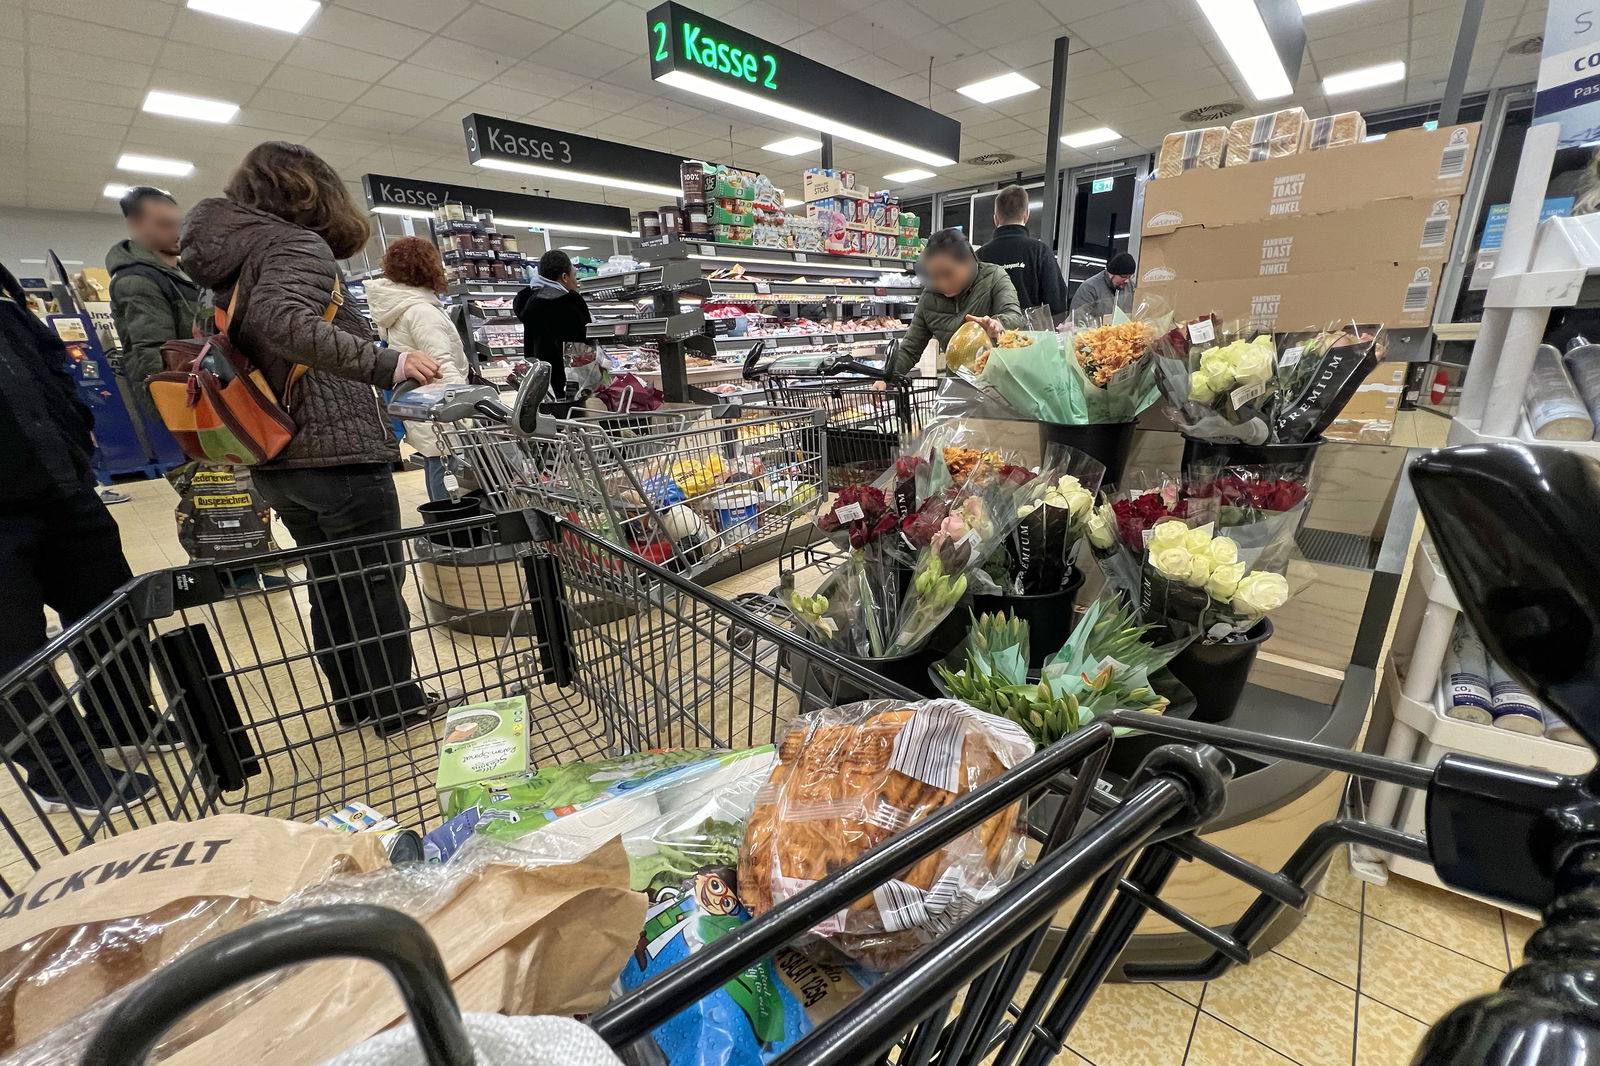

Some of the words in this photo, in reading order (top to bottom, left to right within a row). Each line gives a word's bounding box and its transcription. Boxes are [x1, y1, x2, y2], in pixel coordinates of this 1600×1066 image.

[653, 21, 669, 62] 2
[682, 22, 758, 83] Kasse
[763, 54, 777, 90] 2
[467, 127, 477, 152] 3
[487, 126, 554, 161] Kasse
[559, 140, 572, 164] 3
[1273, 173, 1306, 185] SANDWICH
[379, 182, 438, 207] Kasse
[1272, 182, 1305, 198] TOAST
[1270, 201, 1300, 216] DINKEL
[1263, 236, 1293, 247] SANDWICH
[1261, 245, 1292, 259] TOAST
[1259, 263, 1288, 276] DINKEL
[1251, 302, 1280, 314] TOAST
[1276, 355, 1343, 429] PREMIUM
[198, 495, 250, 507] Ausgezeichnet
[0, 838, 232, 919] ACKWELT
[779, 953, 817, 984] SALAT
